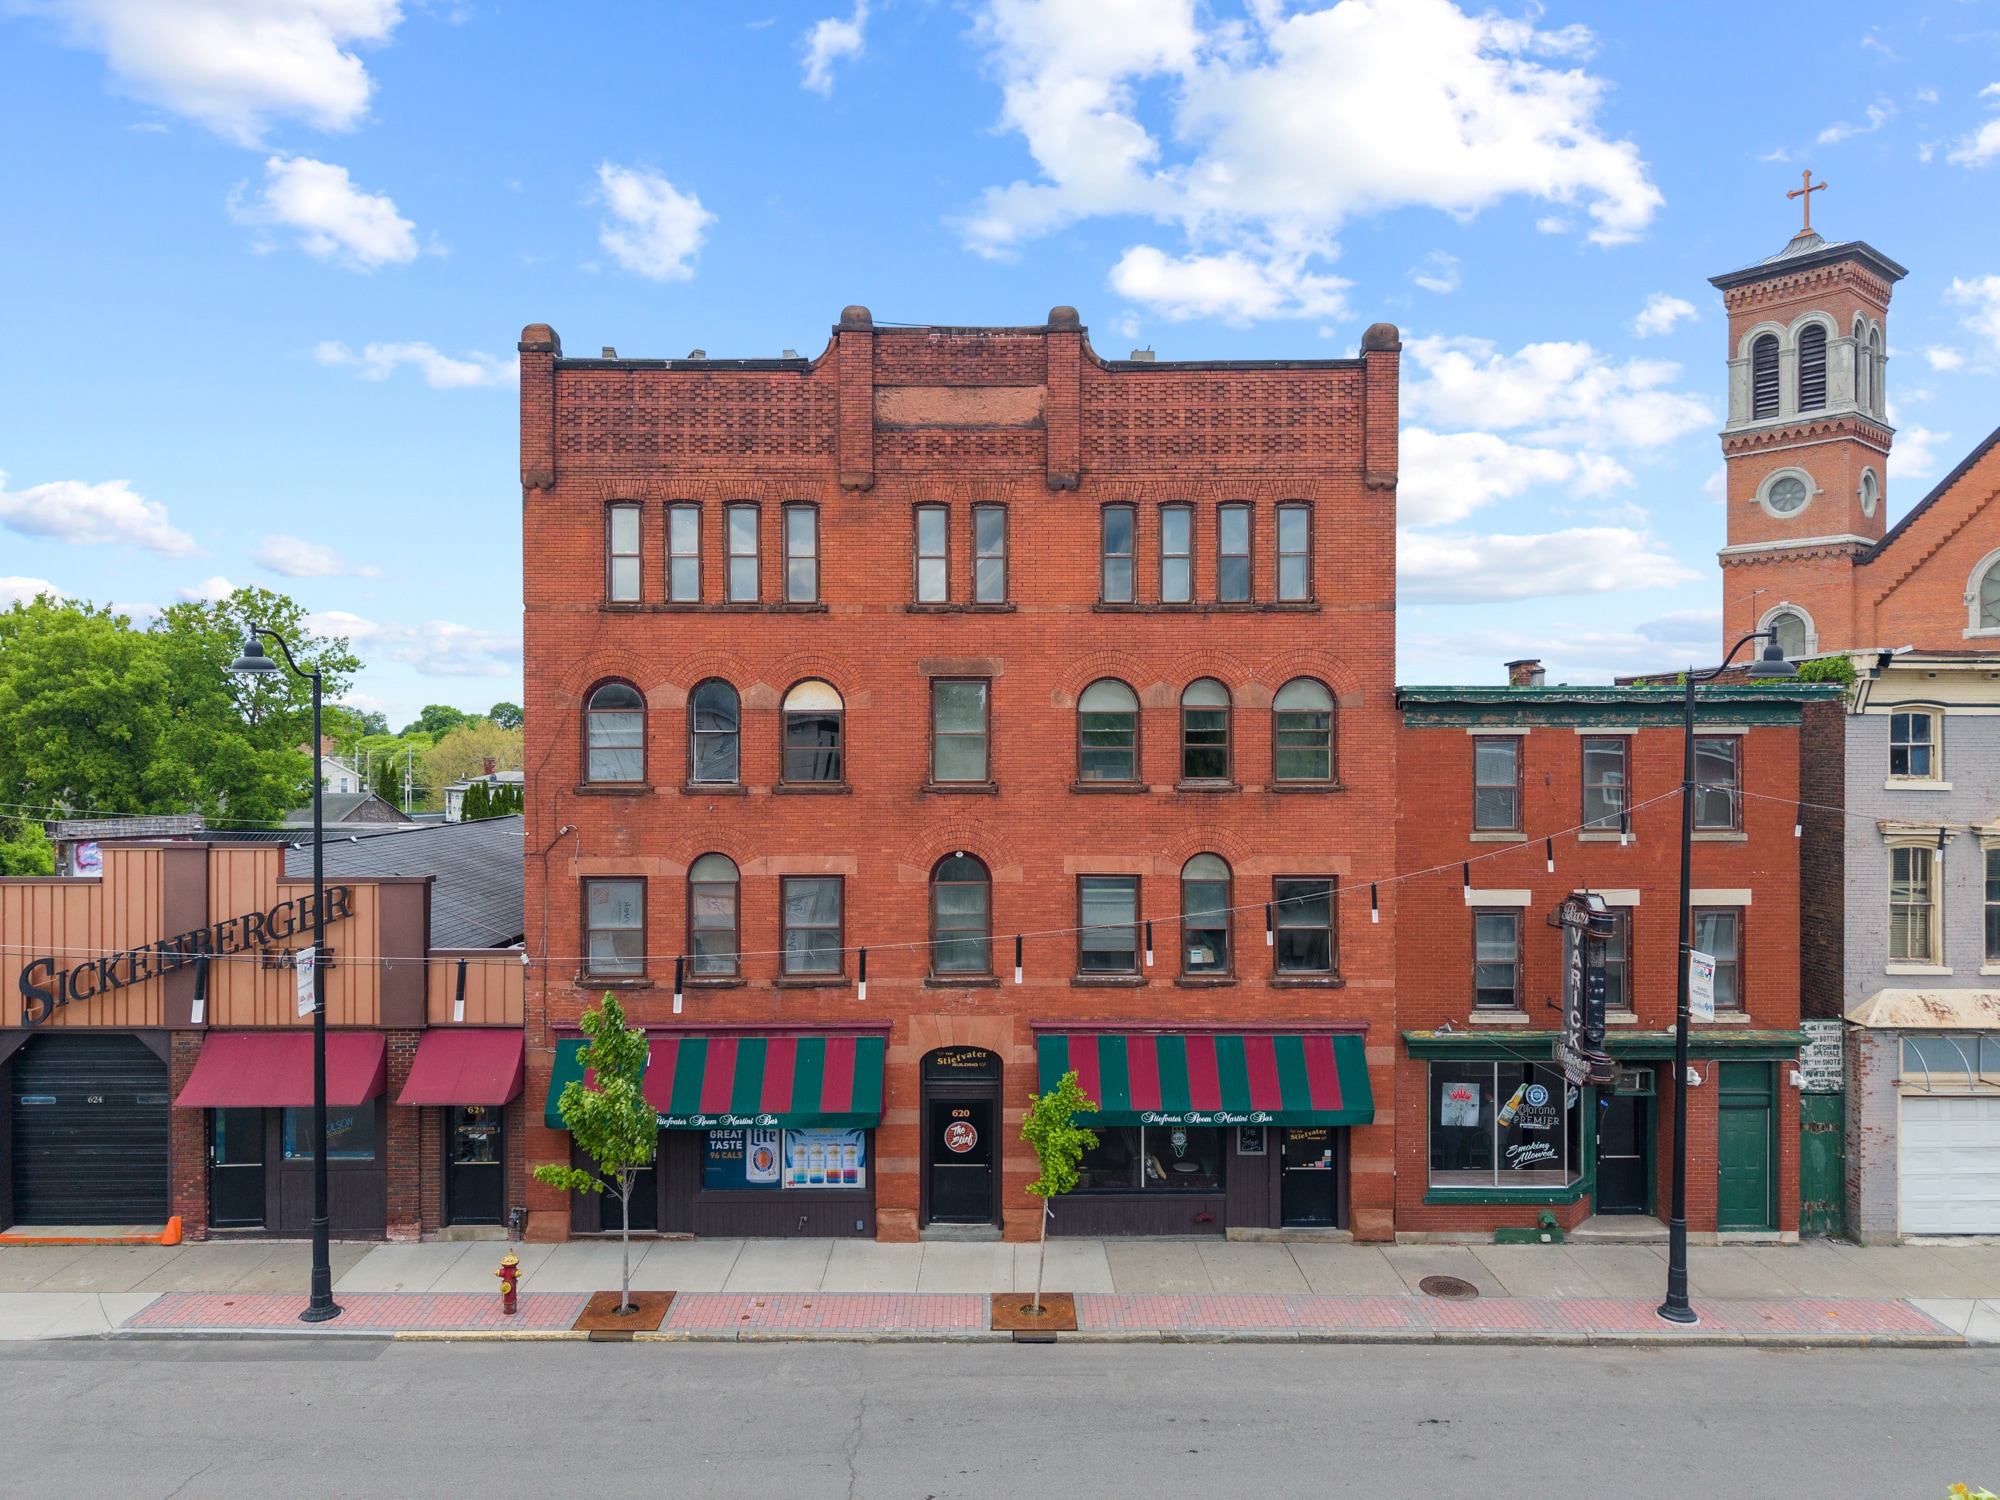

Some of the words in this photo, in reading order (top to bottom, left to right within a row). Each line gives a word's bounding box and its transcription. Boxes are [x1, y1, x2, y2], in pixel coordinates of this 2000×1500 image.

[18, 886, 354, 1027] SICKENBERGER
[260, 948, 336, 970] LAE
[1569, 926, 1582, 1051] VARICK
[937, 1050, 987, 1065] Stiefvater
[87, 1096, 103, 1104] 624
[467, 1106, 485, 1114] 624
[952, 1109, 970, 1117] 620
[1517, 1103, 1556, 1116] Corona
[326, 1116, 353, 1133] OLSON
[689, 1114, 717, 1126] Room
[719, 1114, 754, 1126] Martini
[755, 1113, 778, 1126] Bar
[1141, 1111, 1182, 1125] Stiefvater
[1184, 1112, 1212, 1123] Room
[1214, 1111, 1248, 1123] Martini
[1250, 1111, 1273, 1123] Bar
[1514, 1115, 1560, 1125] PREMIER
[710, 1130, 743, 1138] GREAT
[951, 1125, 965, 1135] The
[751, 1129, 776, 1146] Lite
[710, 1141, 743, 1149] TASTE
[1506, 1141, 1550, 1157] Smoking
[710, 1151, 719, 1159] 96
[722, 1151, 743, 1159] CALS
[1512, 1148, 1555, 1168] Allowed
